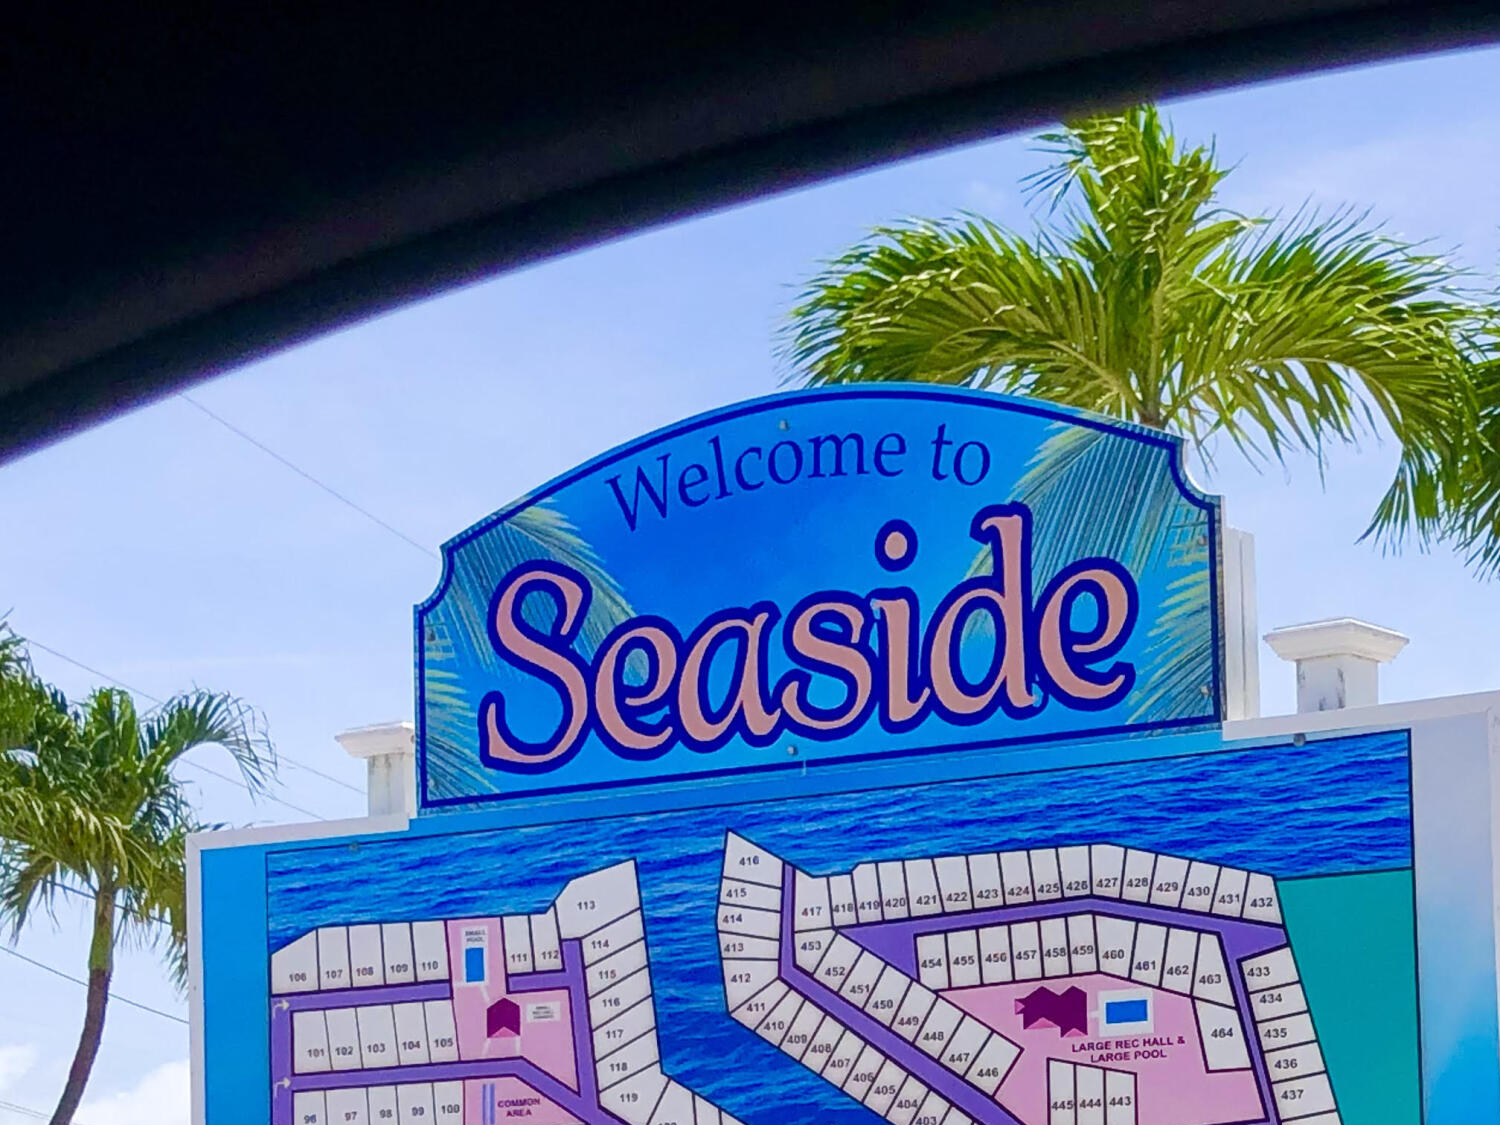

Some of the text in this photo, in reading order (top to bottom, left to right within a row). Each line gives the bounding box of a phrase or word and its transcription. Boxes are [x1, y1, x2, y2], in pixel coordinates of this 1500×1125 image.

[606, 422, 991, 532] Welcome to
[478, 500, 1137, 775] Seaside
[1096, 878, 1118, 888] 427
[726, 888, 746, 898] 415
[1008, 886, 1029, 896] 424
[916, 895, 936, 905] 421
[802, 906, 822, 916] 417
[722, 914, 742, 923] 414
[592, 940, 609, 948] 114
[511, 954, 526, 962] 111
[1016, 950, 1036, 960] 457
[921, 958, 942, 968] 454
[953, 956, 974, 966] 455
[599, 970, 616, 979] 115
[825, 967, 845, 976] 452
[731, 973, 750, 982] 412
[606, 1029, 623, 1038] 117
[1072, 1036, 1185, 1052] LARGE REC HALL &
[949, 1053, 970, 1063] 447
[1091, 1050, 1167, 1063] LARGE POOL
[507, 1109, 532, 1117] AREA
